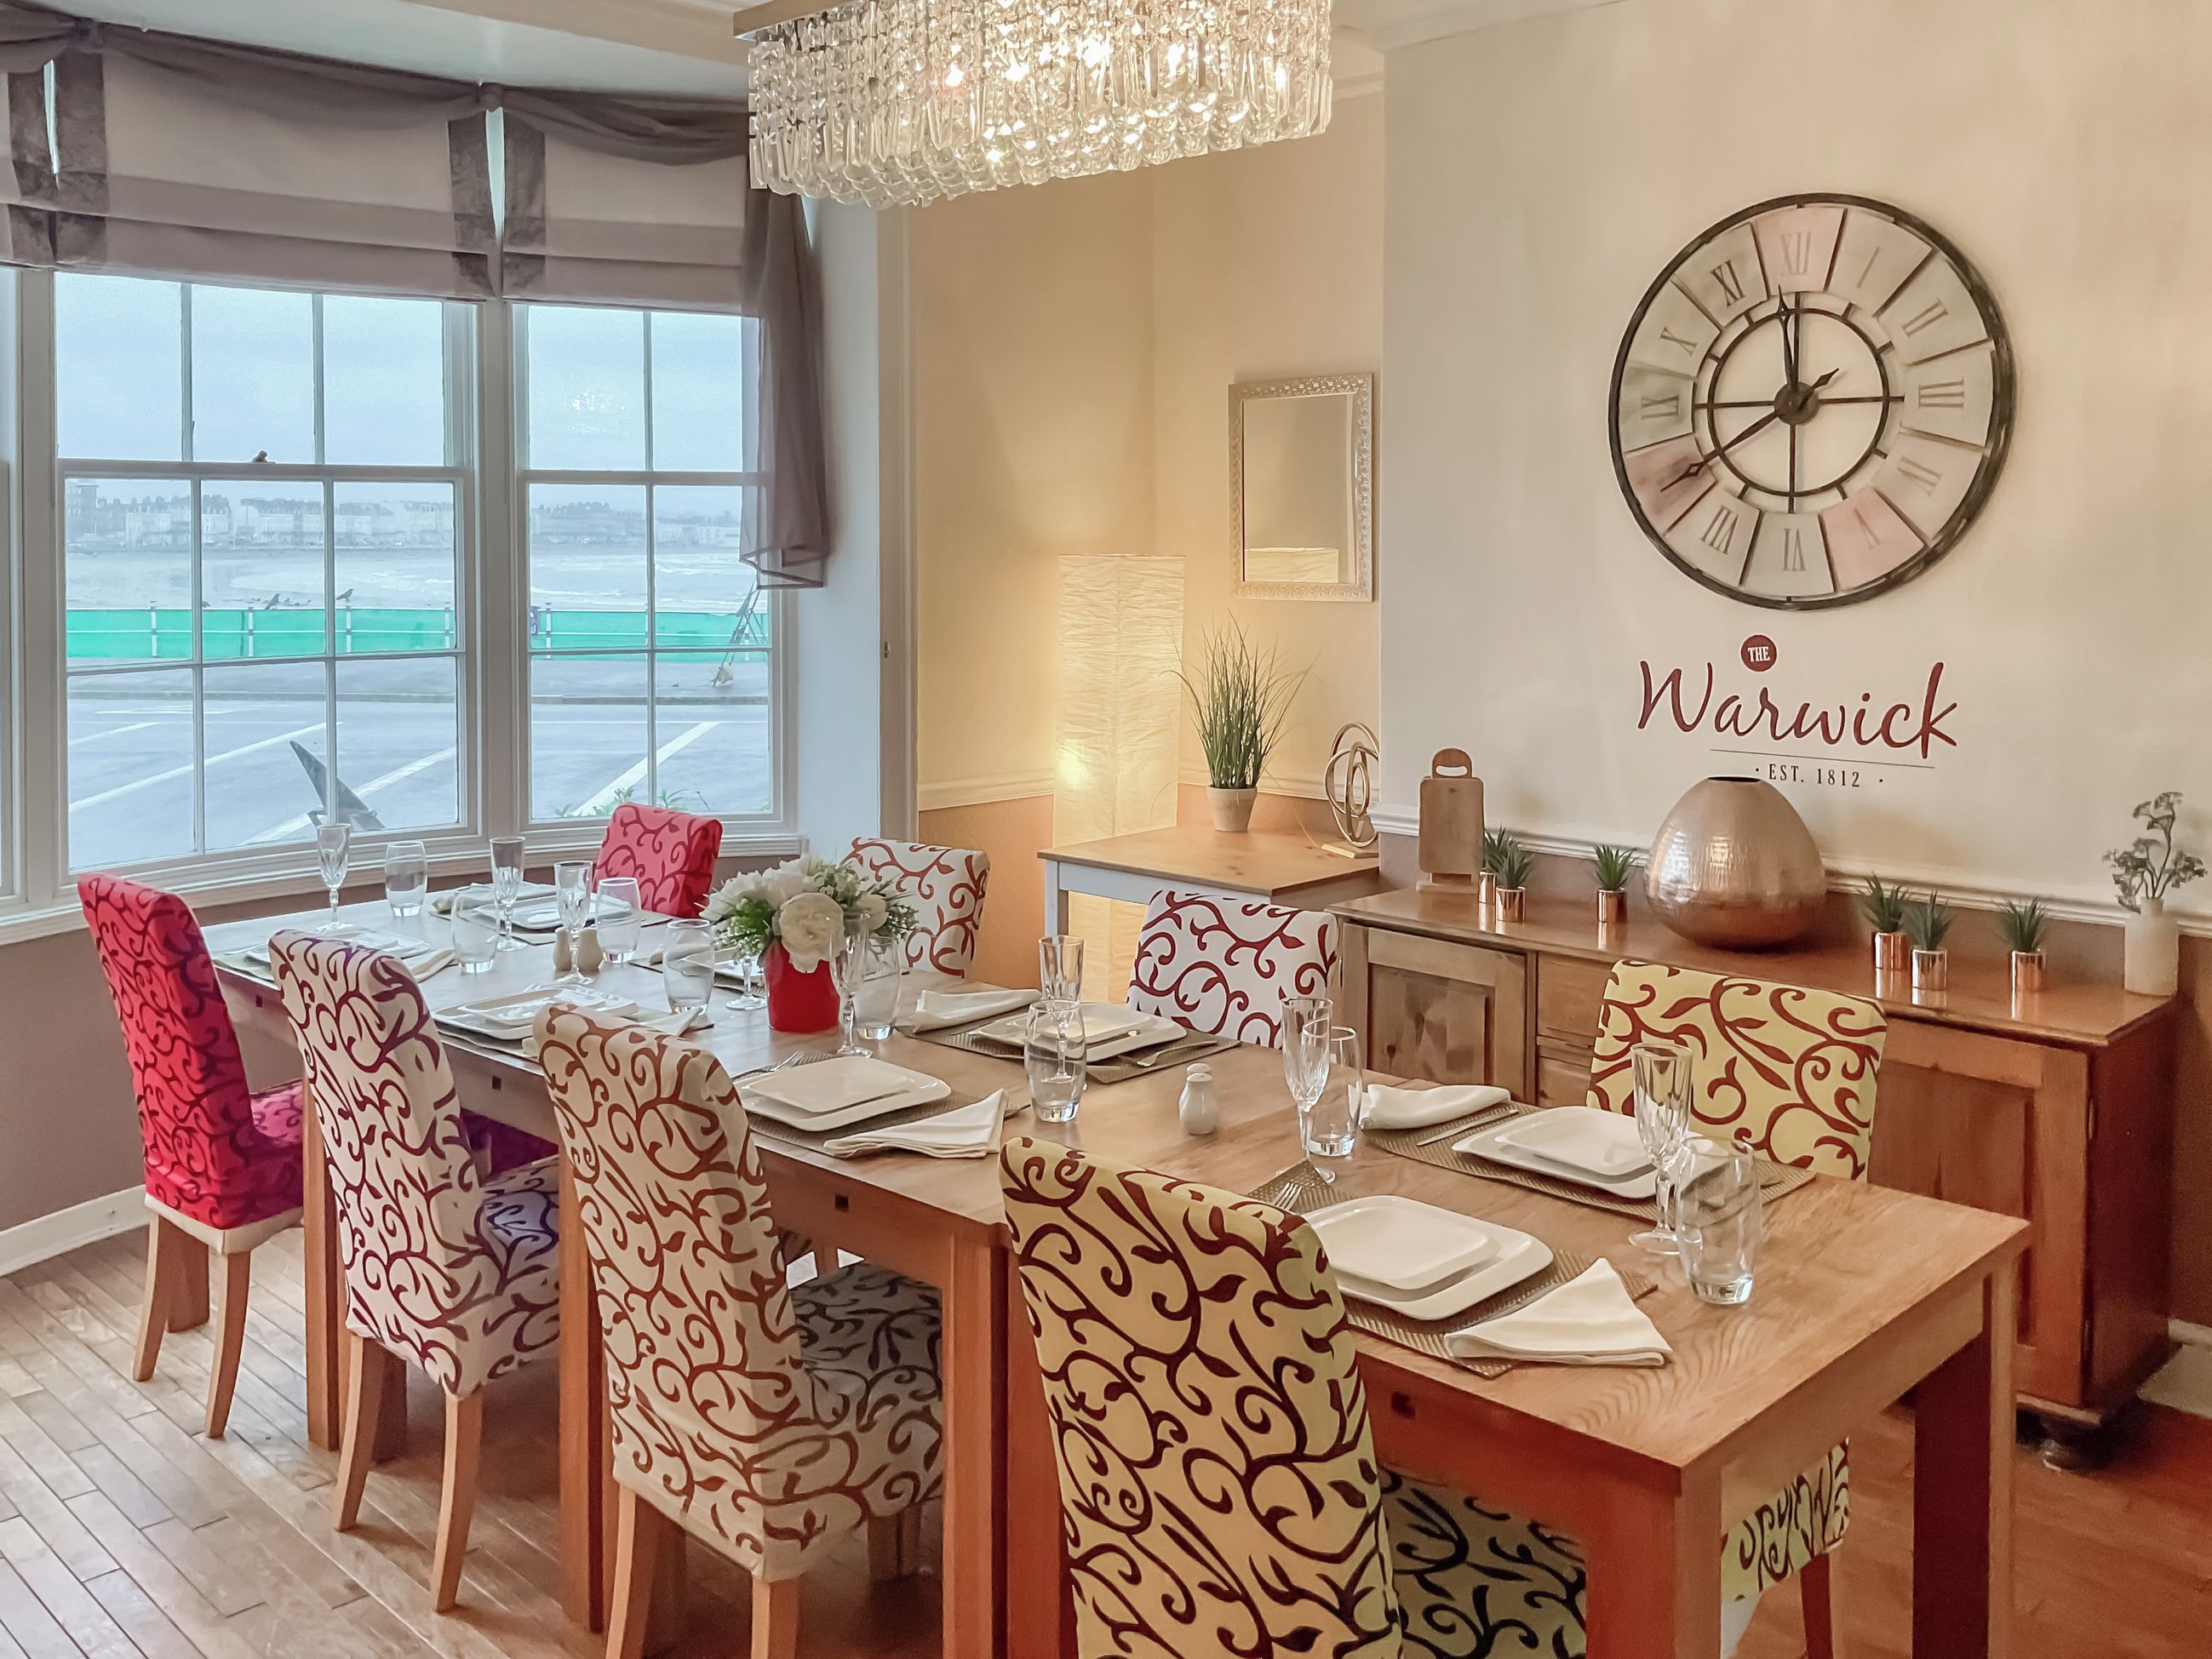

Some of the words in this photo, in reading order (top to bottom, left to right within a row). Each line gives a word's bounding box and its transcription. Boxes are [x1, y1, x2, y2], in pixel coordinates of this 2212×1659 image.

[1711, 260, 1745, 307] XI
[1659, 326, 1699, 356] X
[1747, 646, 1771, 662] THE
[1637, 661, 1957, 759] Warwick
[1768, 764, 1804, 782] EST.
[1817, 768, 1860, 787] 1812
